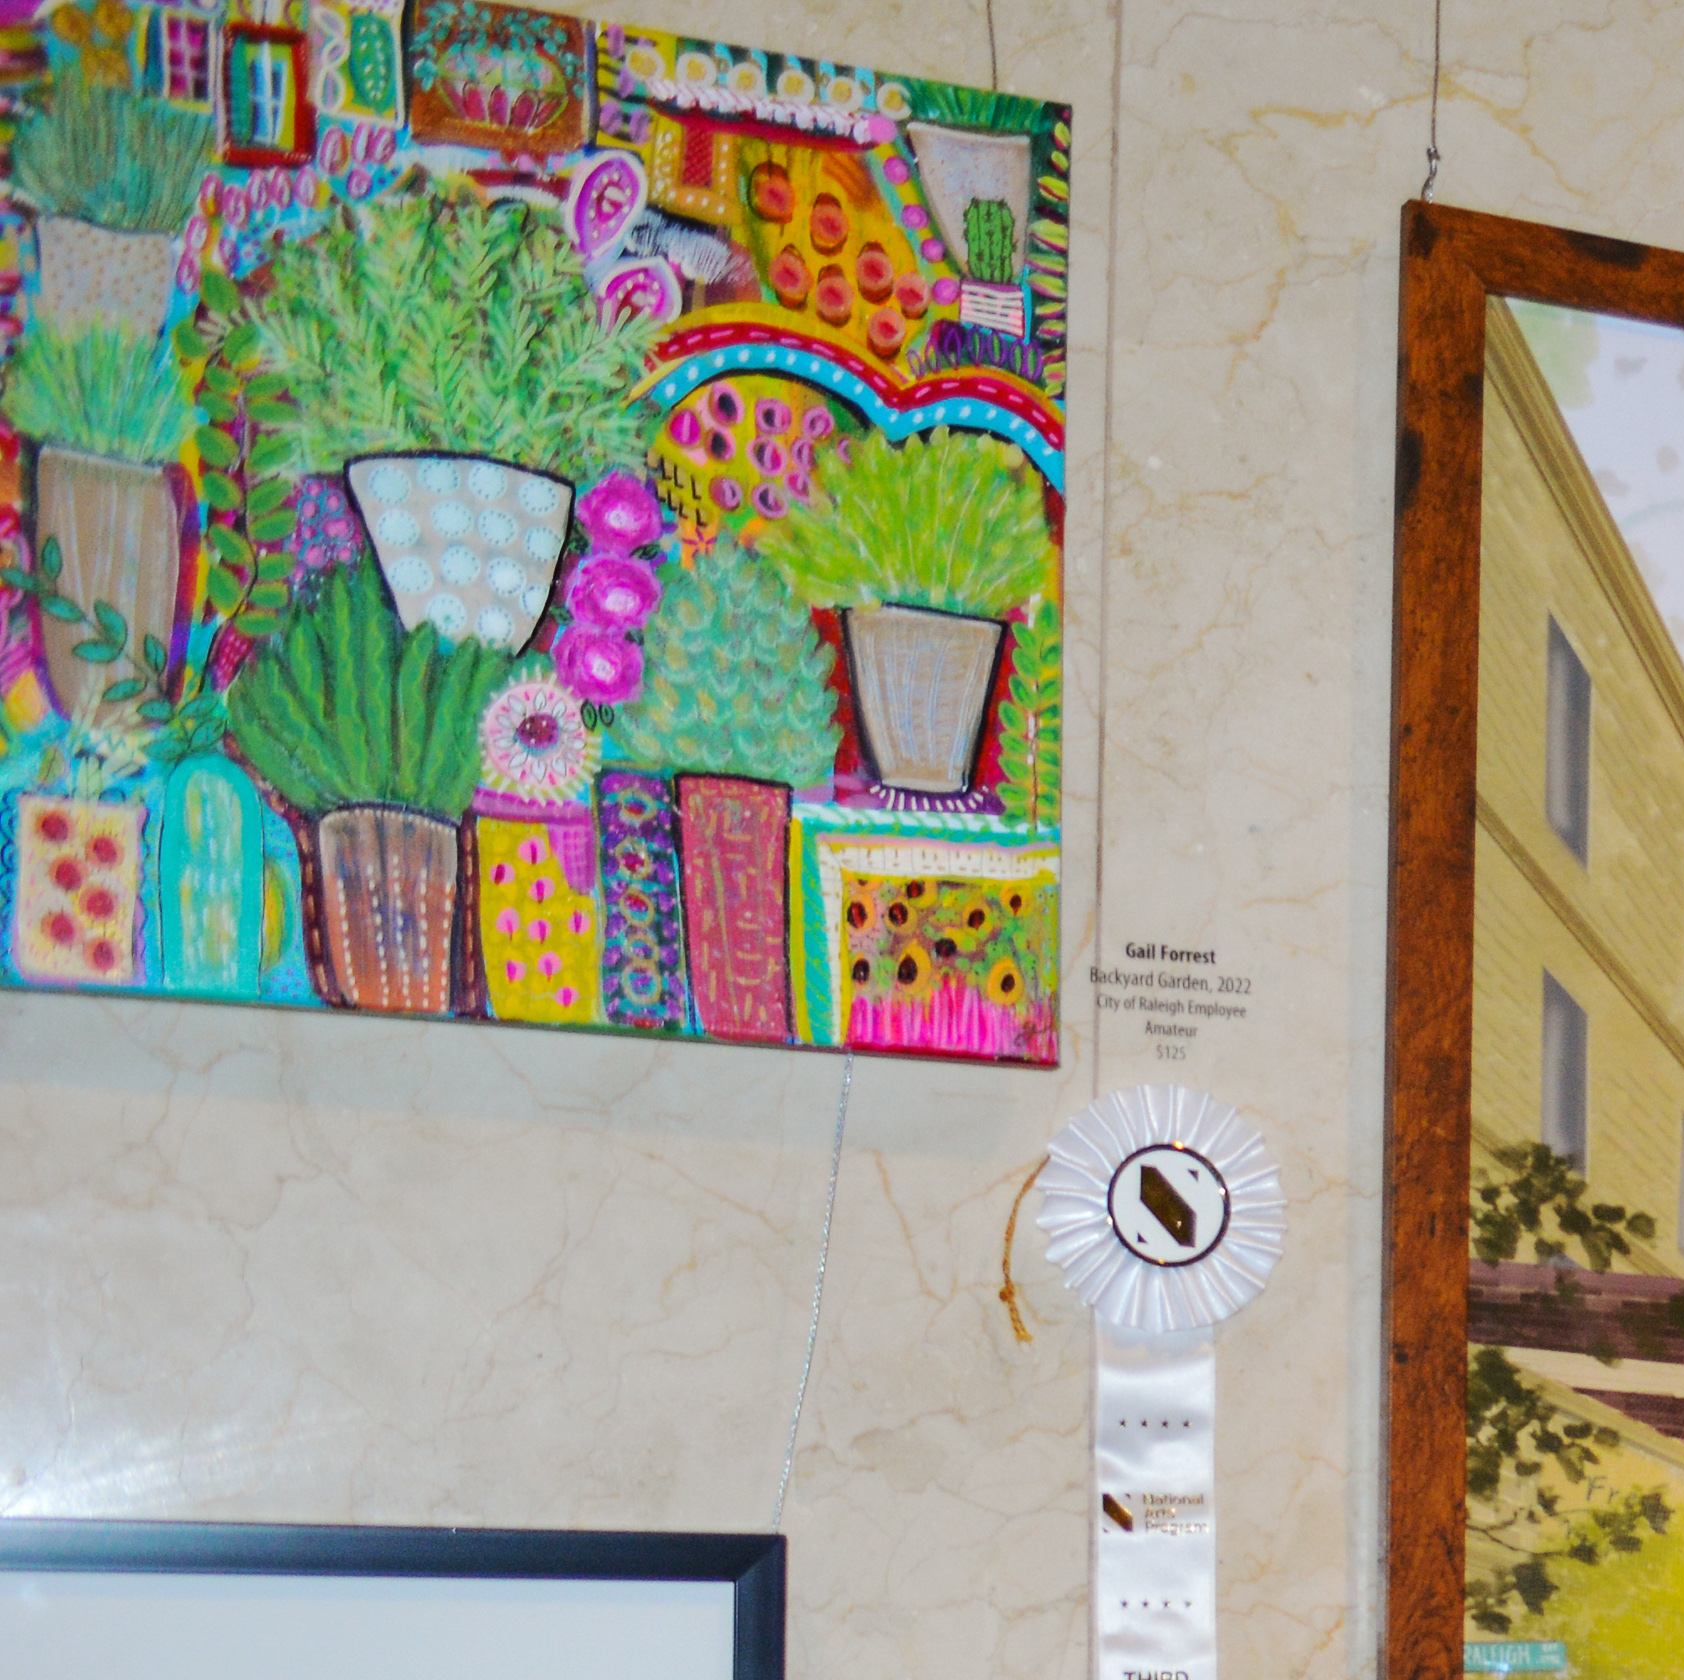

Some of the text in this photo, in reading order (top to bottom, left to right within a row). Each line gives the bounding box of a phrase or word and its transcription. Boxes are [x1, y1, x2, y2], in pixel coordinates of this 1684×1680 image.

[1125, 942, 1217, 965] Gail Forrest
[1089, 967, 1252, 995] Backyard Garden, 2022
[1096, 994, 1247, 1019] City of Raleigh Employee
[1145, 1021, 1198, 1037] Amateur
[1143, 1493, 1204, 1505] National
[1145, 1520, 1209, 1536] Program
